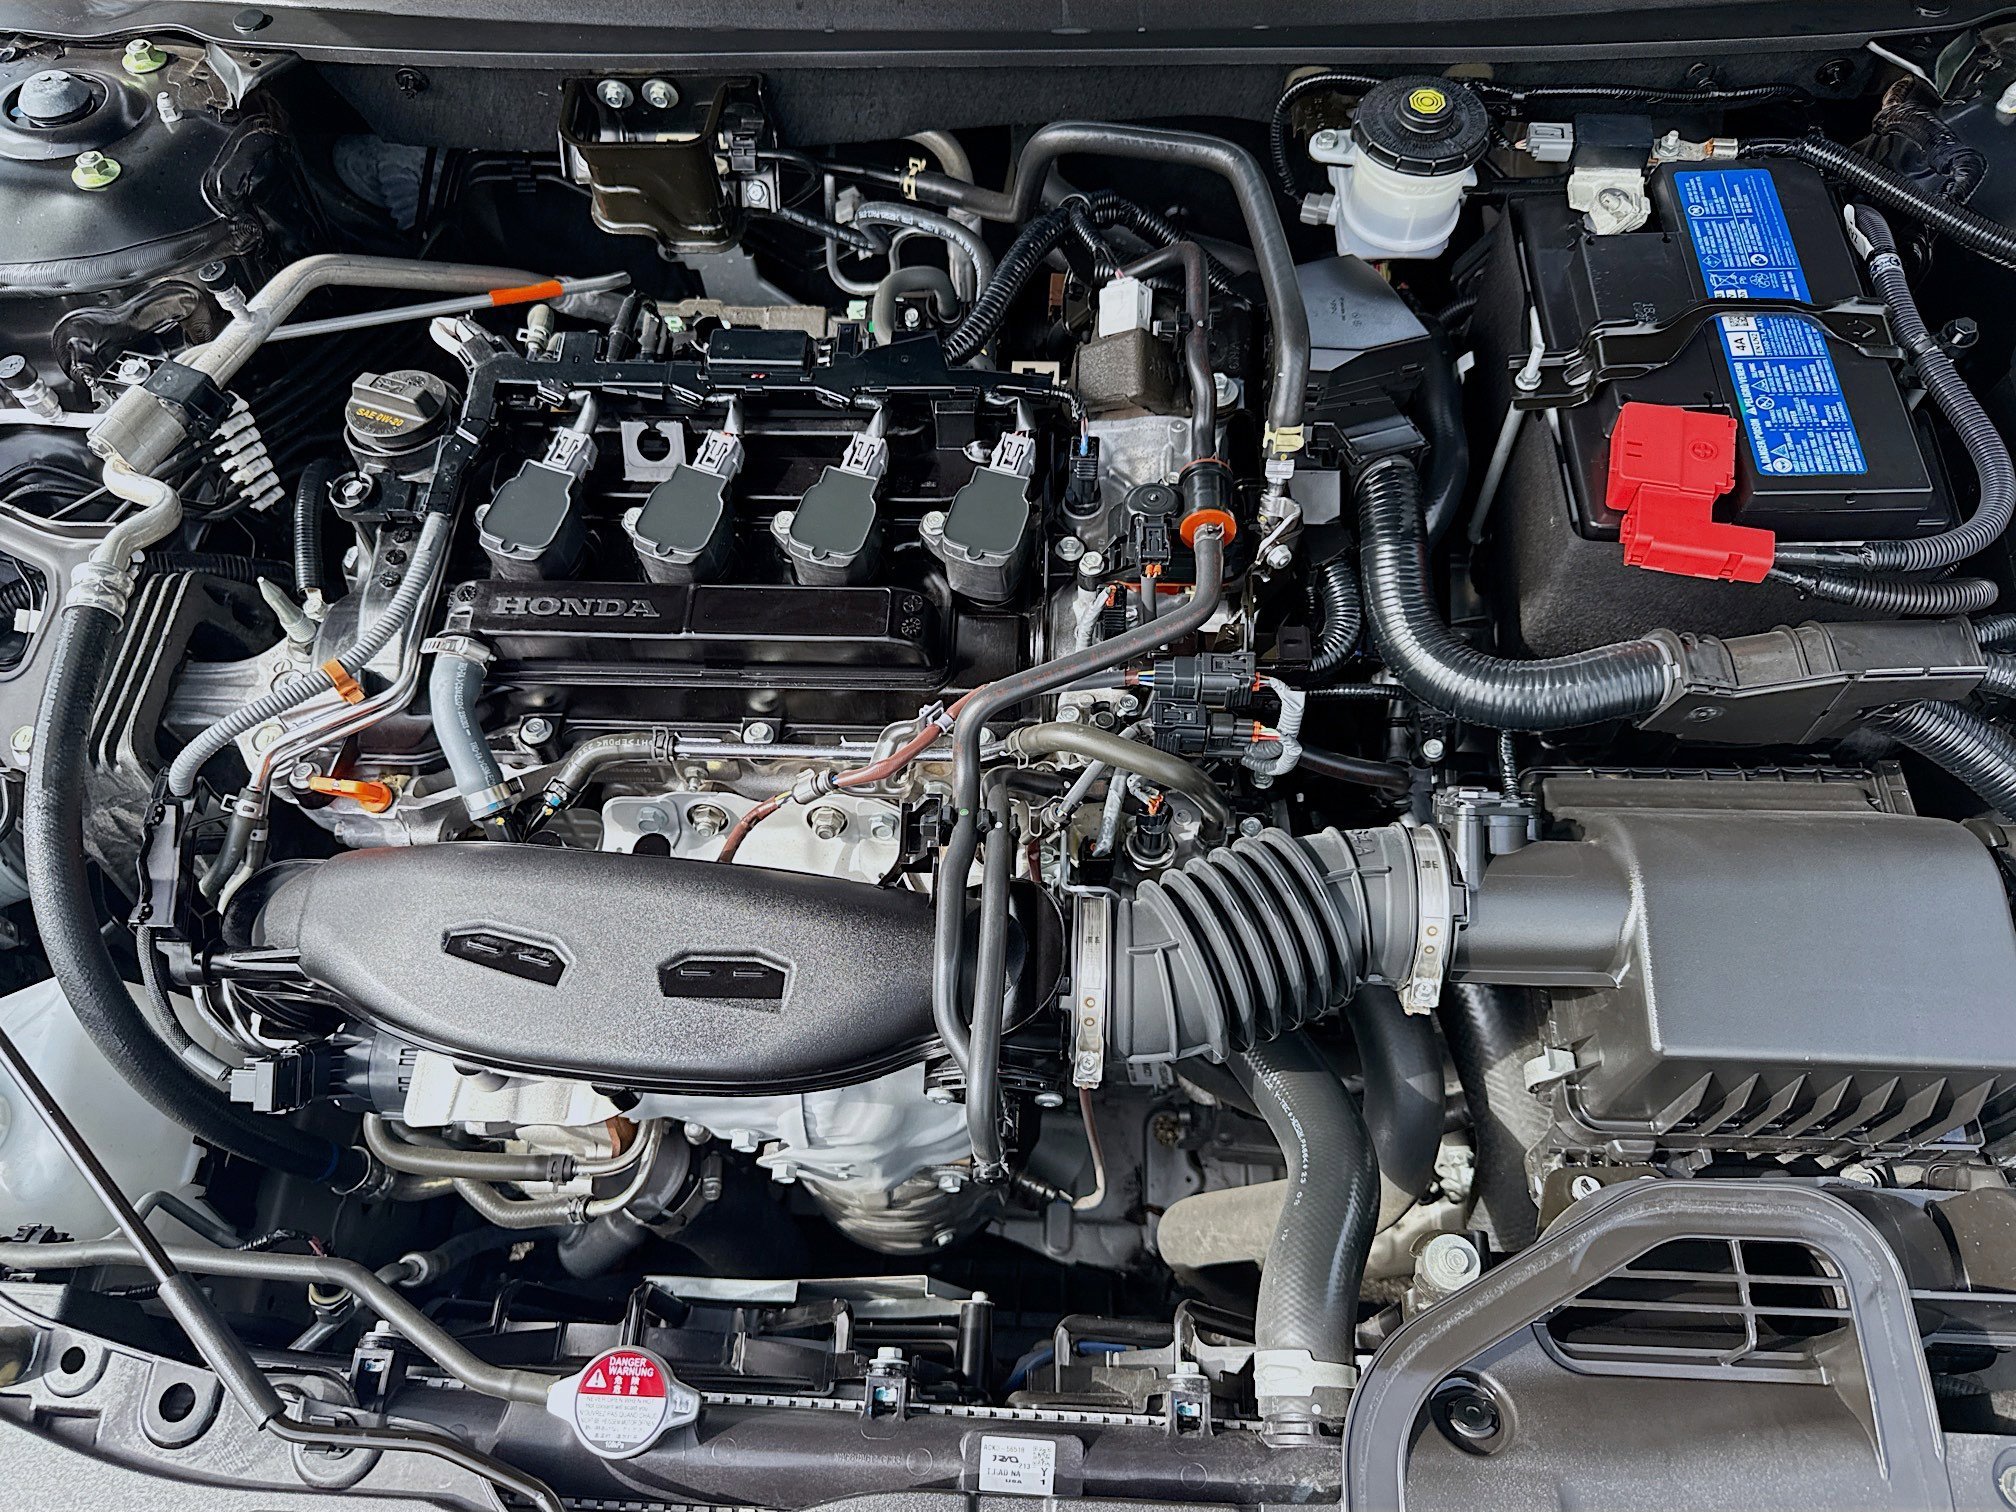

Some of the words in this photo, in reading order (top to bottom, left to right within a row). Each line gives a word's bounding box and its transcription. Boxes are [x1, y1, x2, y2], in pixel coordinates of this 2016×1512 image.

[1732, 337, 1747, 350] 4A
[1750, 333, 1759, 344] LN2
[1754, 345, 1762, 353] EN
[1733, 361, 1755, 406] PELIGRO/VENENO
[356, 408, 377, 419] SAE
[376, 415, 404, 427] 0W-20
[1749, 418, 1771, 463] DANGER/POISON
[492, 596, 660, 618] HONDA
[610, 1356, 646, 1367] DANGER
[608, 1365, 654, 1376] WARNUNG
[1041, 1467, 1048, 1477] Y
